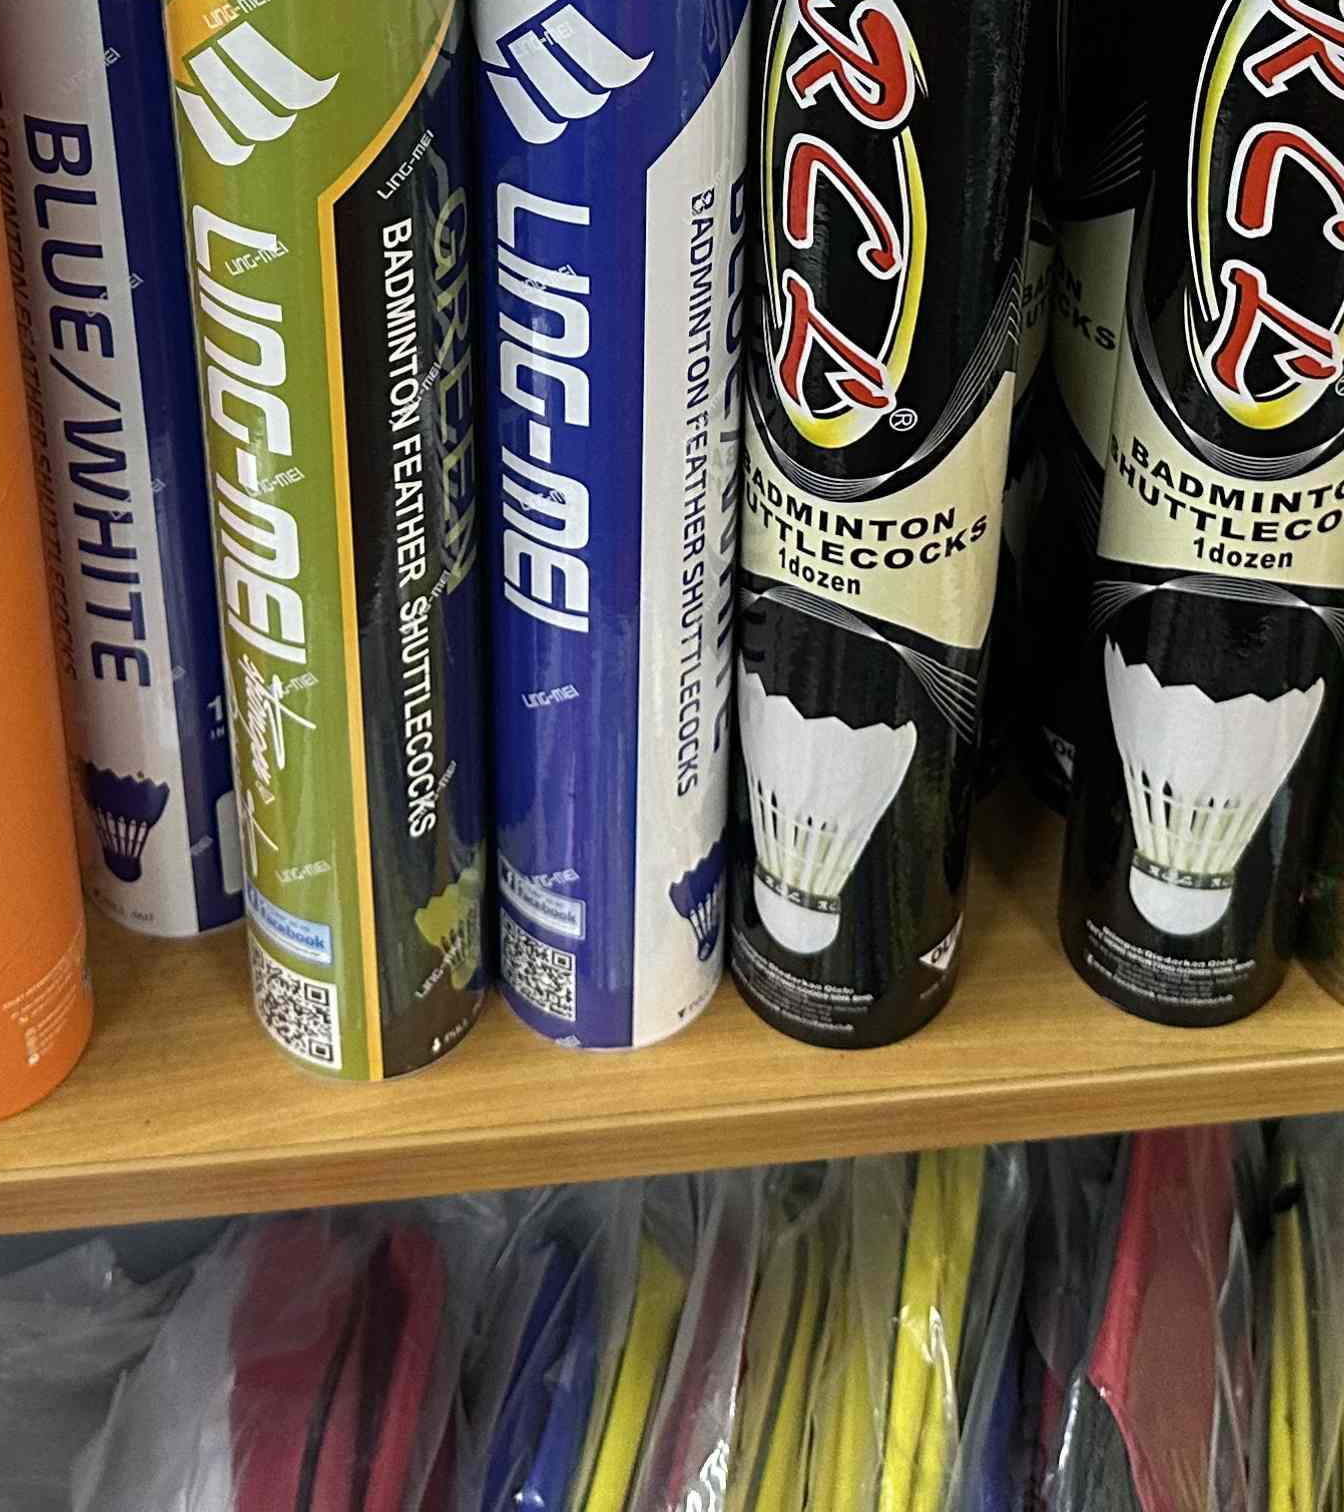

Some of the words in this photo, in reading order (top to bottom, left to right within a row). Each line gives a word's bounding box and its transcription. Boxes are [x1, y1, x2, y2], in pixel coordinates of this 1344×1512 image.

[376, 128, 435, 201] LING-MEI
[381, 217, 419, 433] BADMINTON
[684, 187, 716, 411] BADMINTON
[23, 114, 153, 691] BLUE/WHITE
[392, 433, 429, 588] FEATHER
[680, 409, 709, 561] FEATHER
[744, 482, 989, 570] UTTLECOCKS
[1192, 537, 1294, 571] 1dozen
[777, 547, 863, 596] 1dozen
[399, 593, 436, 839] SHUTTLECOCKS
[676, 562, 705, 798] SHUTTLECOCKS
